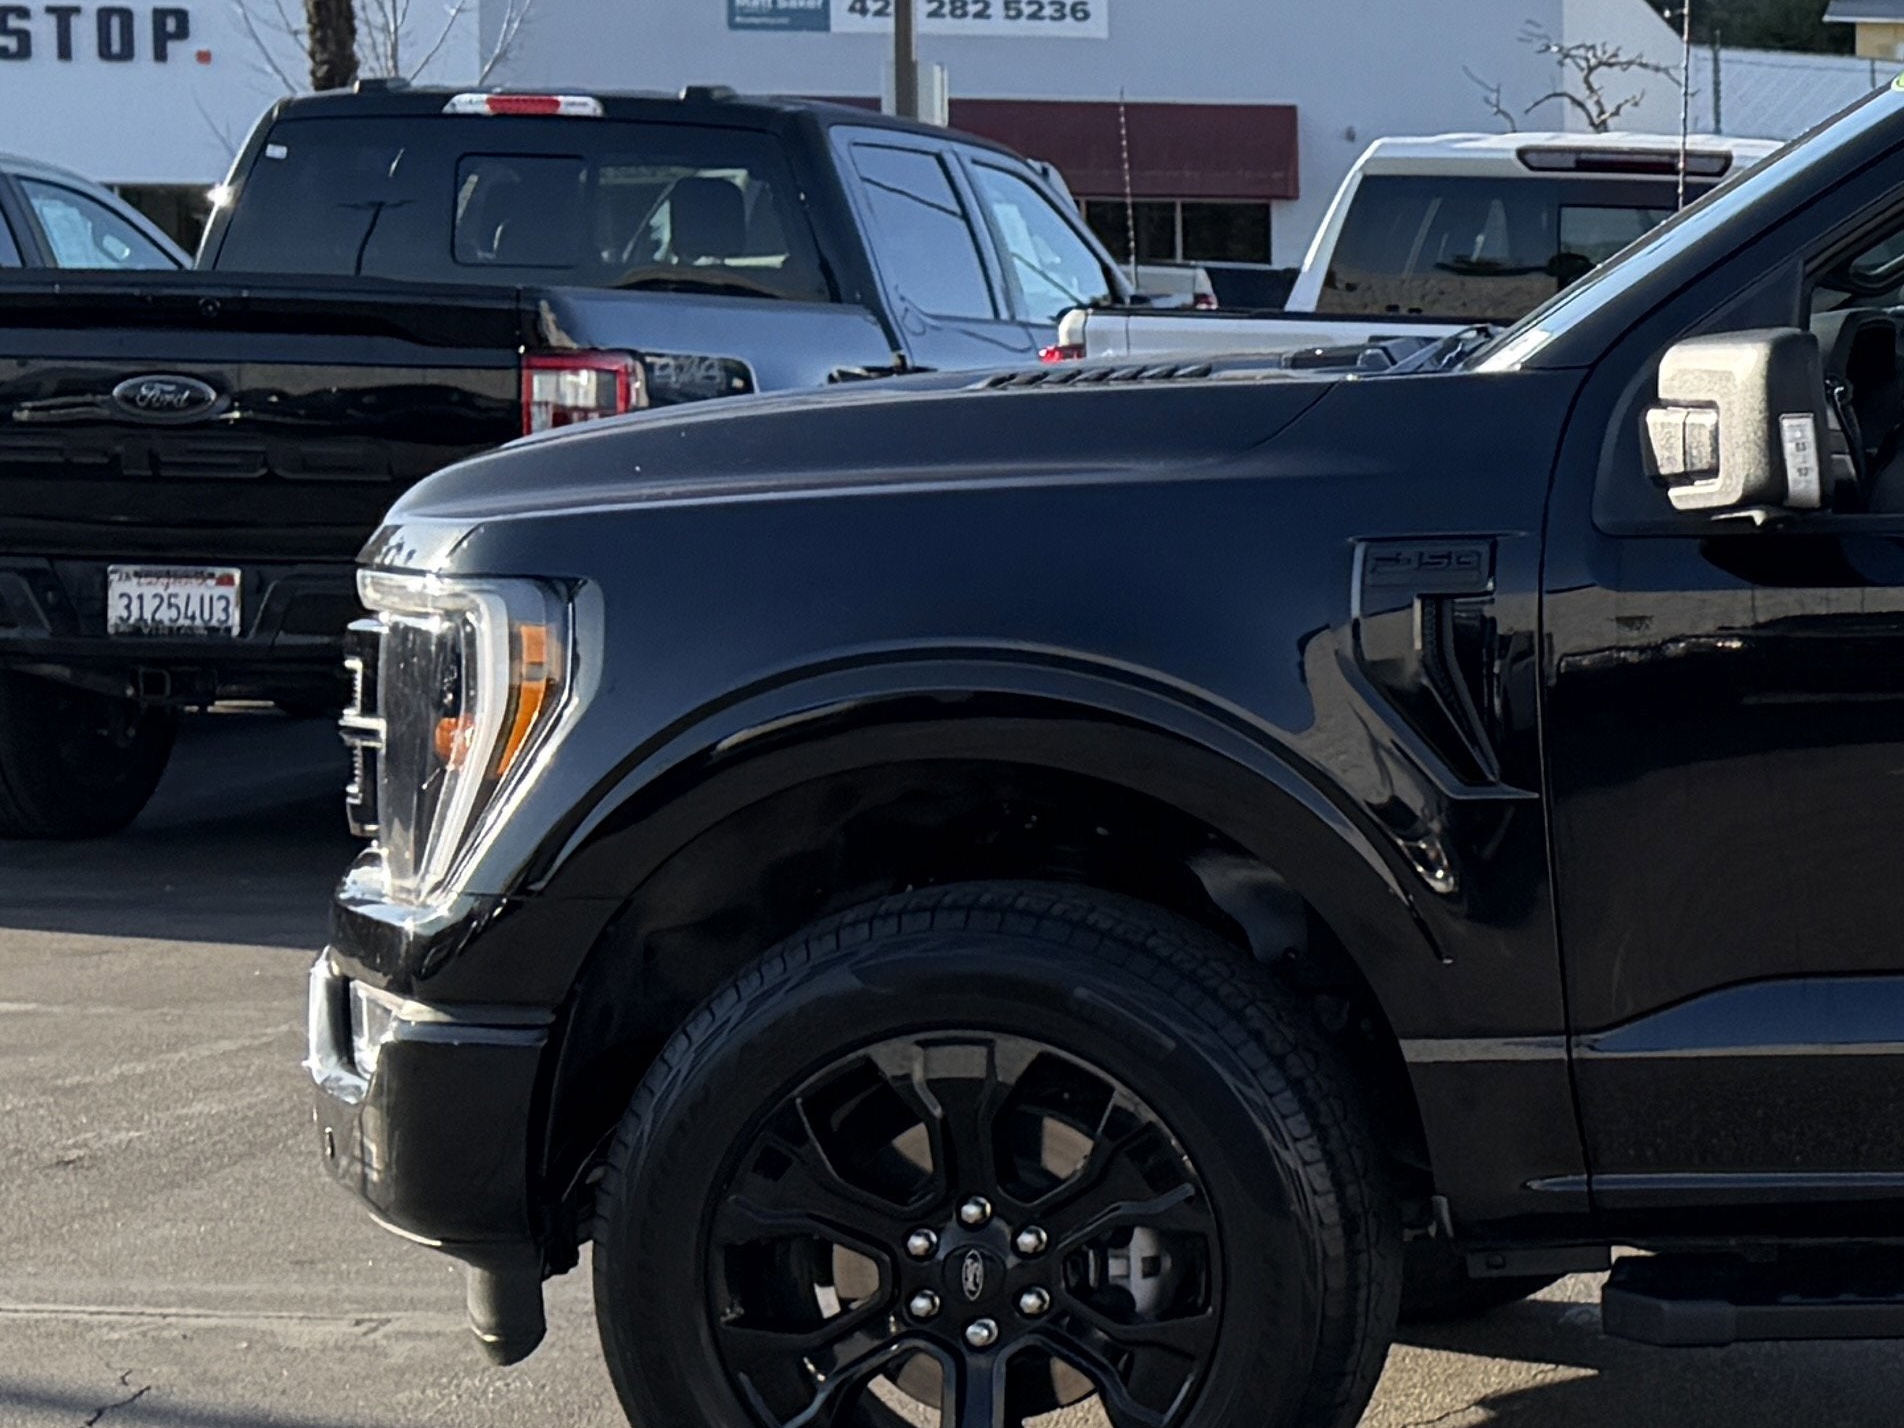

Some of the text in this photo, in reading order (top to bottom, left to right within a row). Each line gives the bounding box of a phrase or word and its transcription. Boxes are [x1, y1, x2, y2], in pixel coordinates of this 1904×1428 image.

[1003, 0, 1091, 22] 5236
[136, 382, 190, 408] Ford
[118, 593, 231, 626] 31254U3
